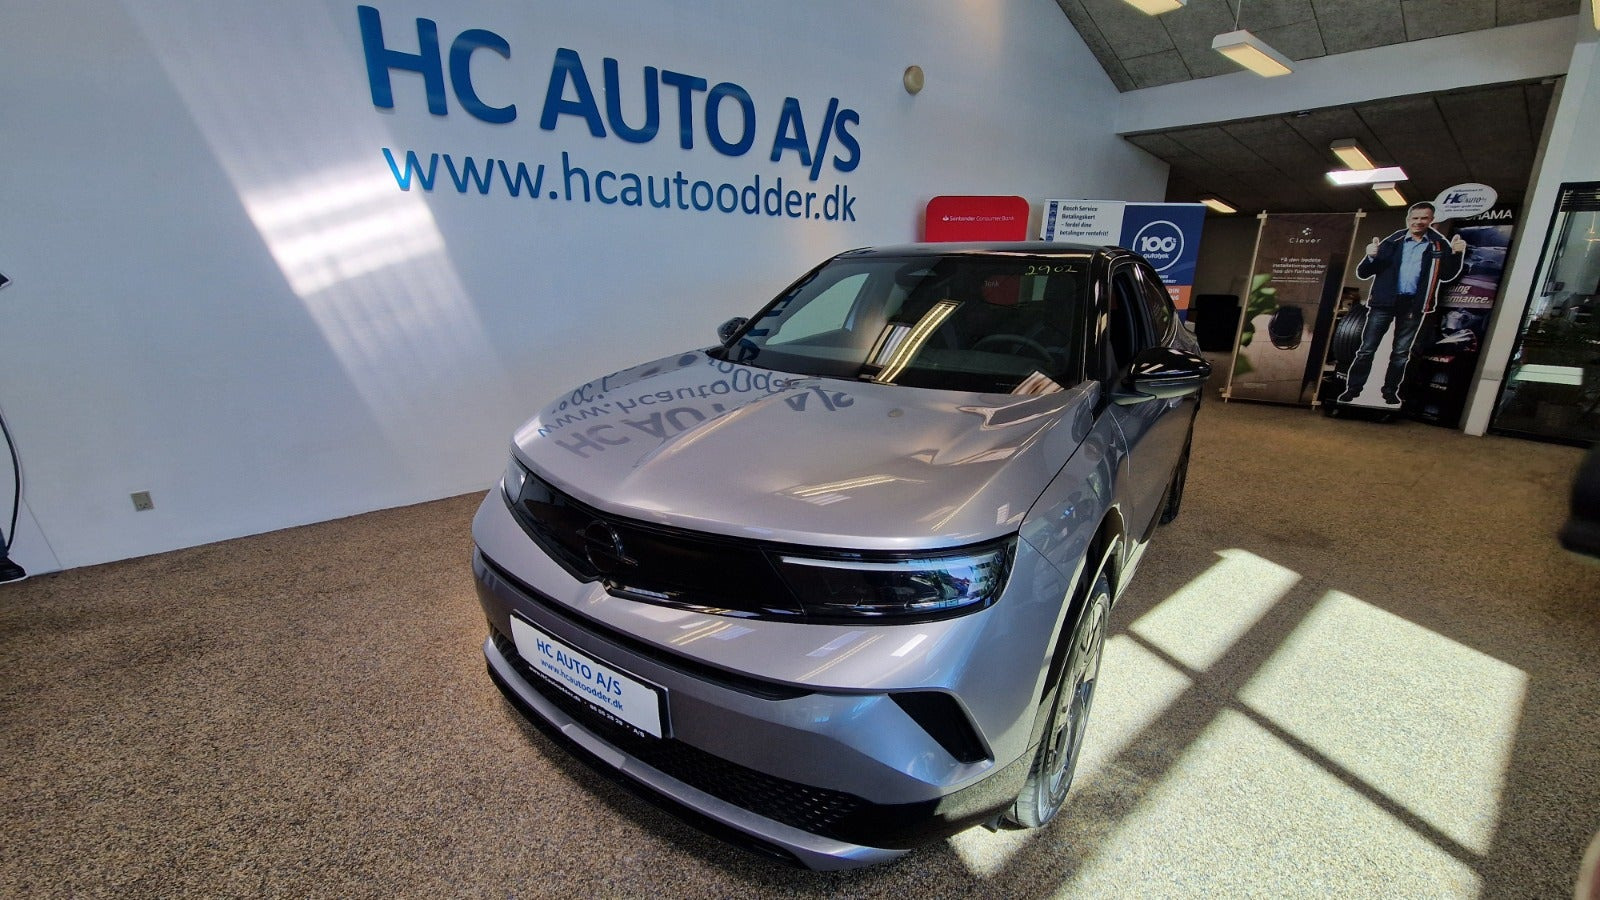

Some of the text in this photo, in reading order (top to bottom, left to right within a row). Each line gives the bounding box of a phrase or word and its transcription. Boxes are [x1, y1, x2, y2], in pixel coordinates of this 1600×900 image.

[357, 5, 861, 181] HC AUTO A/S
[381, 147, 856, 222] www.hcautoodder.dk
[1059, 229, 1085, 237] betalinger
[1024, 264, 1079, 276] 2902
[536, 637, 622, 696] HC AUTO A/S
[541, 659, 624, 711] www.hcautoodder.dk
